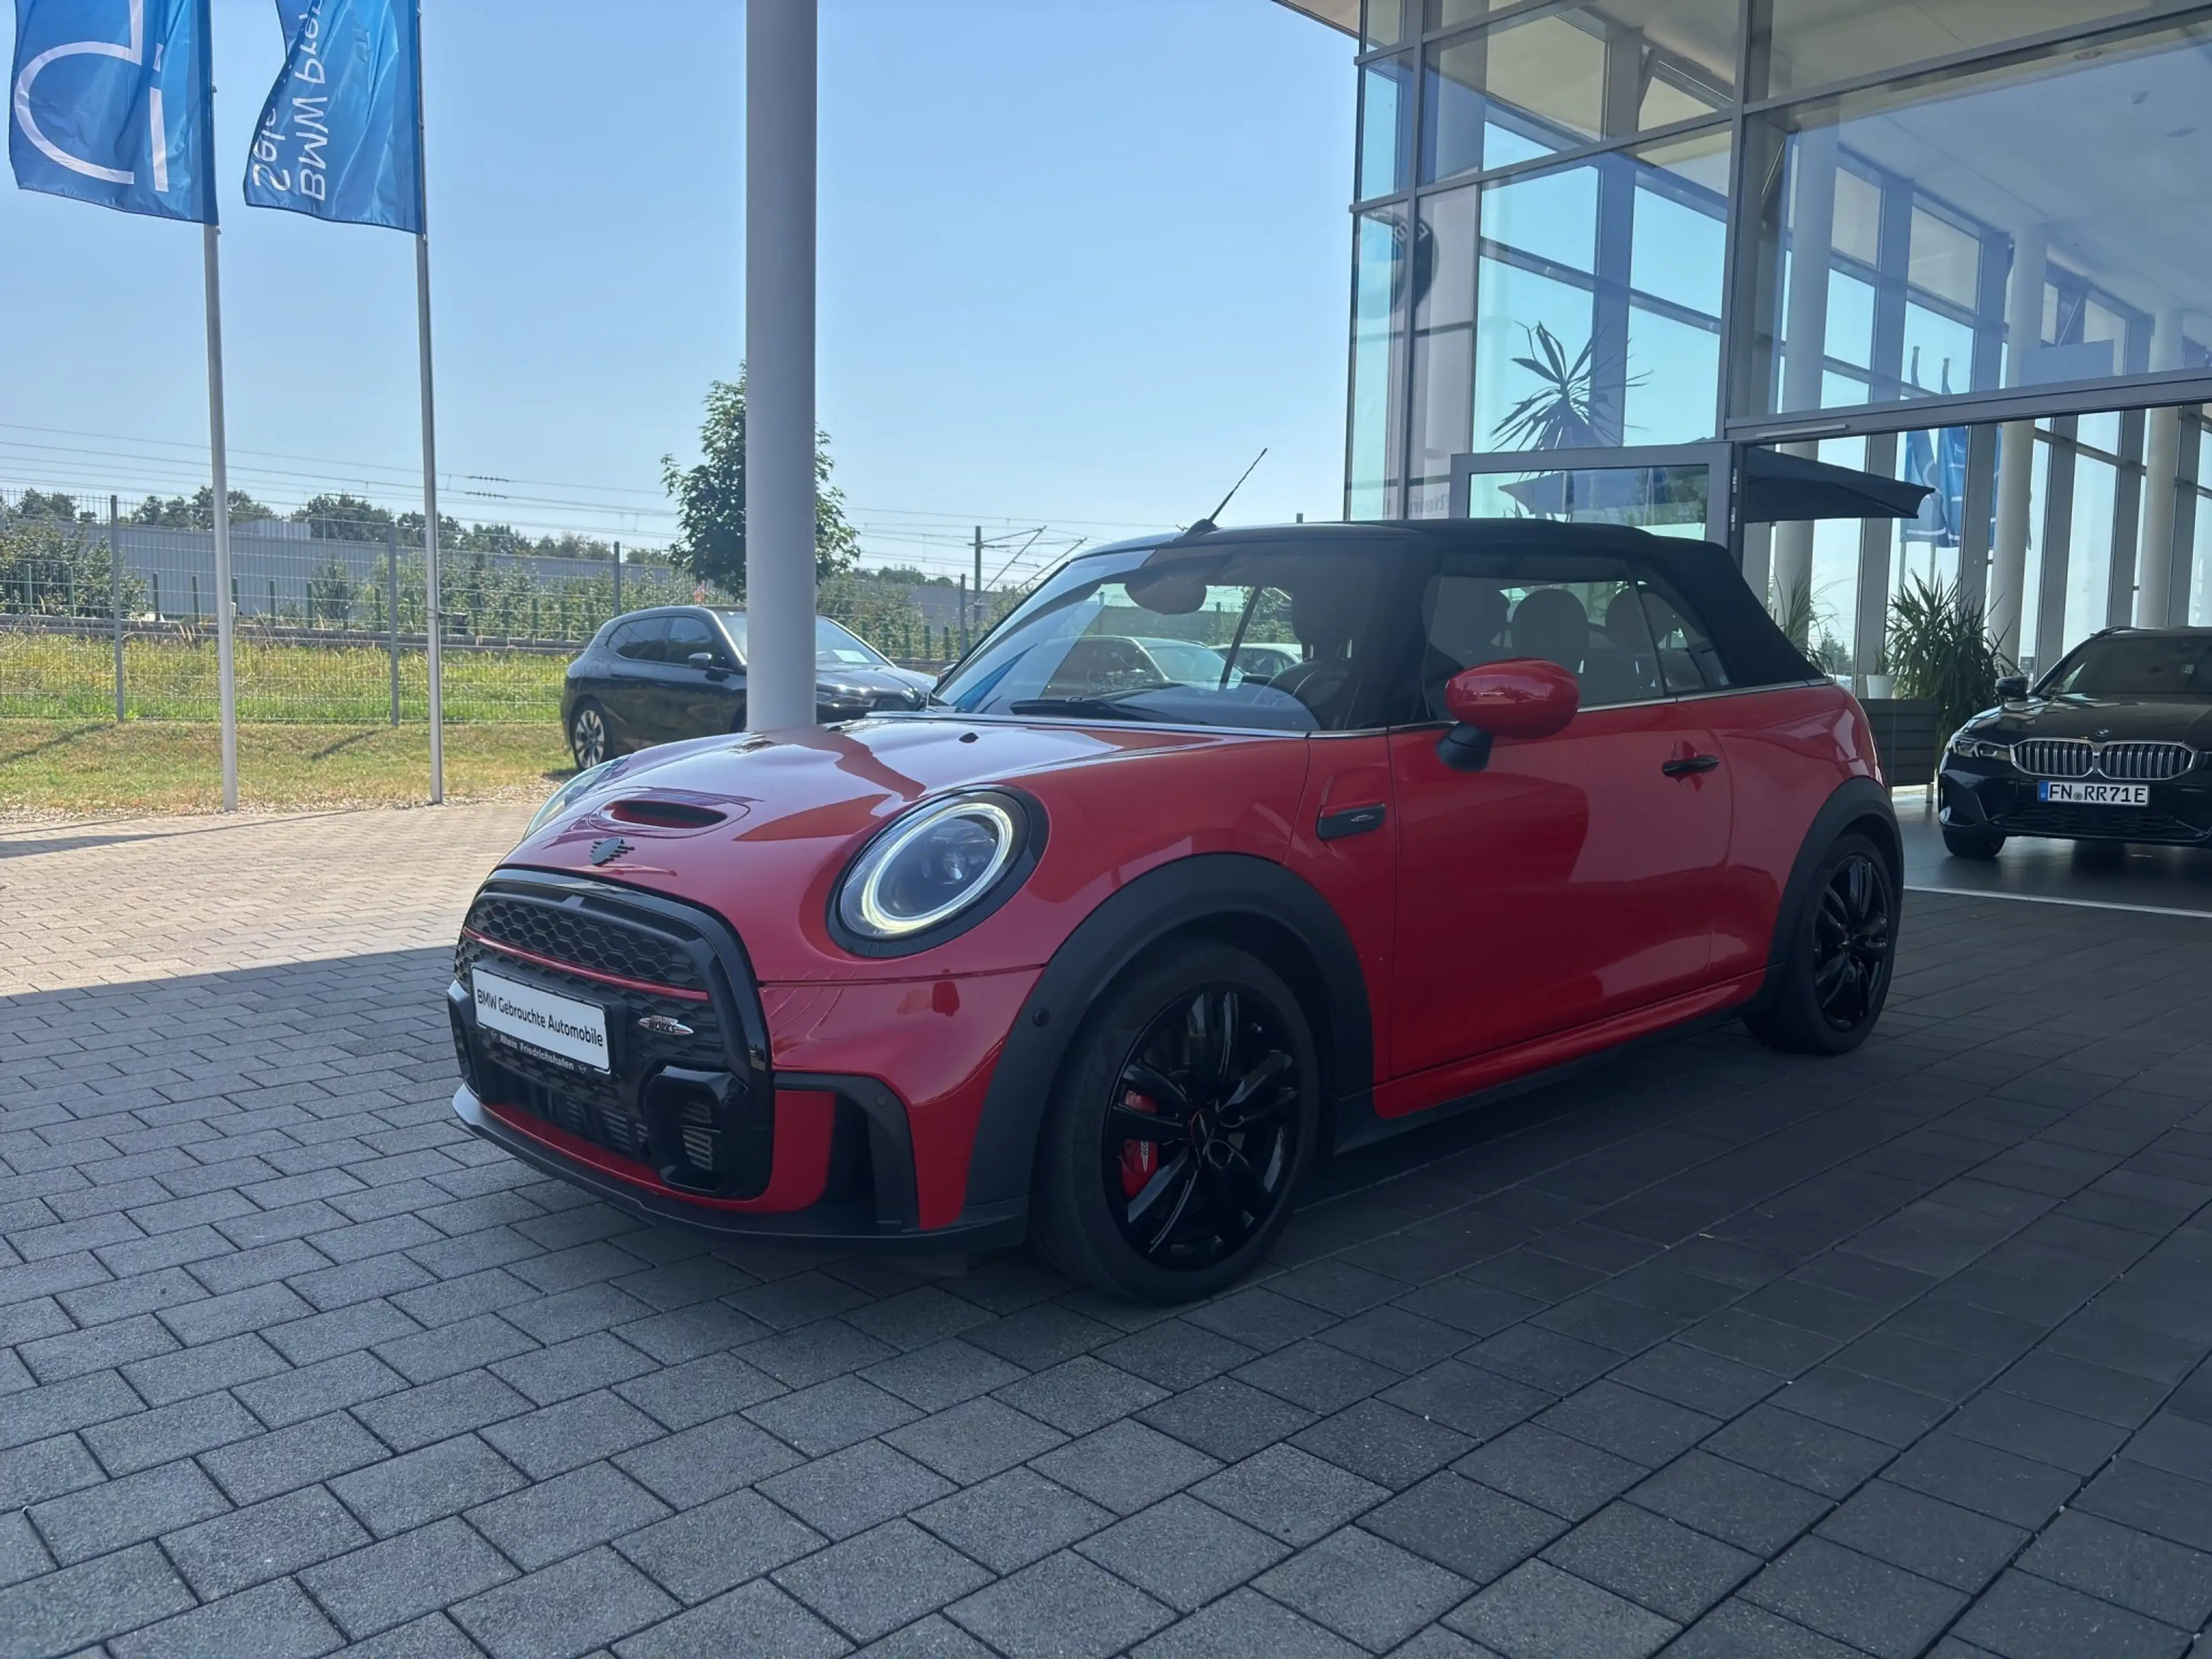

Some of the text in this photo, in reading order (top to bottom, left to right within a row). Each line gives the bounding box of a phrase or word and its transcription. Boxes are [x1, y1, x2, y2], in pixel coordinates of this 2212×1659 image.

[2049, 784, 2073, 800] FN
[477, 988, 604, 1047] BMW Gebrauchte Automobile
[500, 1035, 574, 1070] Rhein Friedrichshafen
